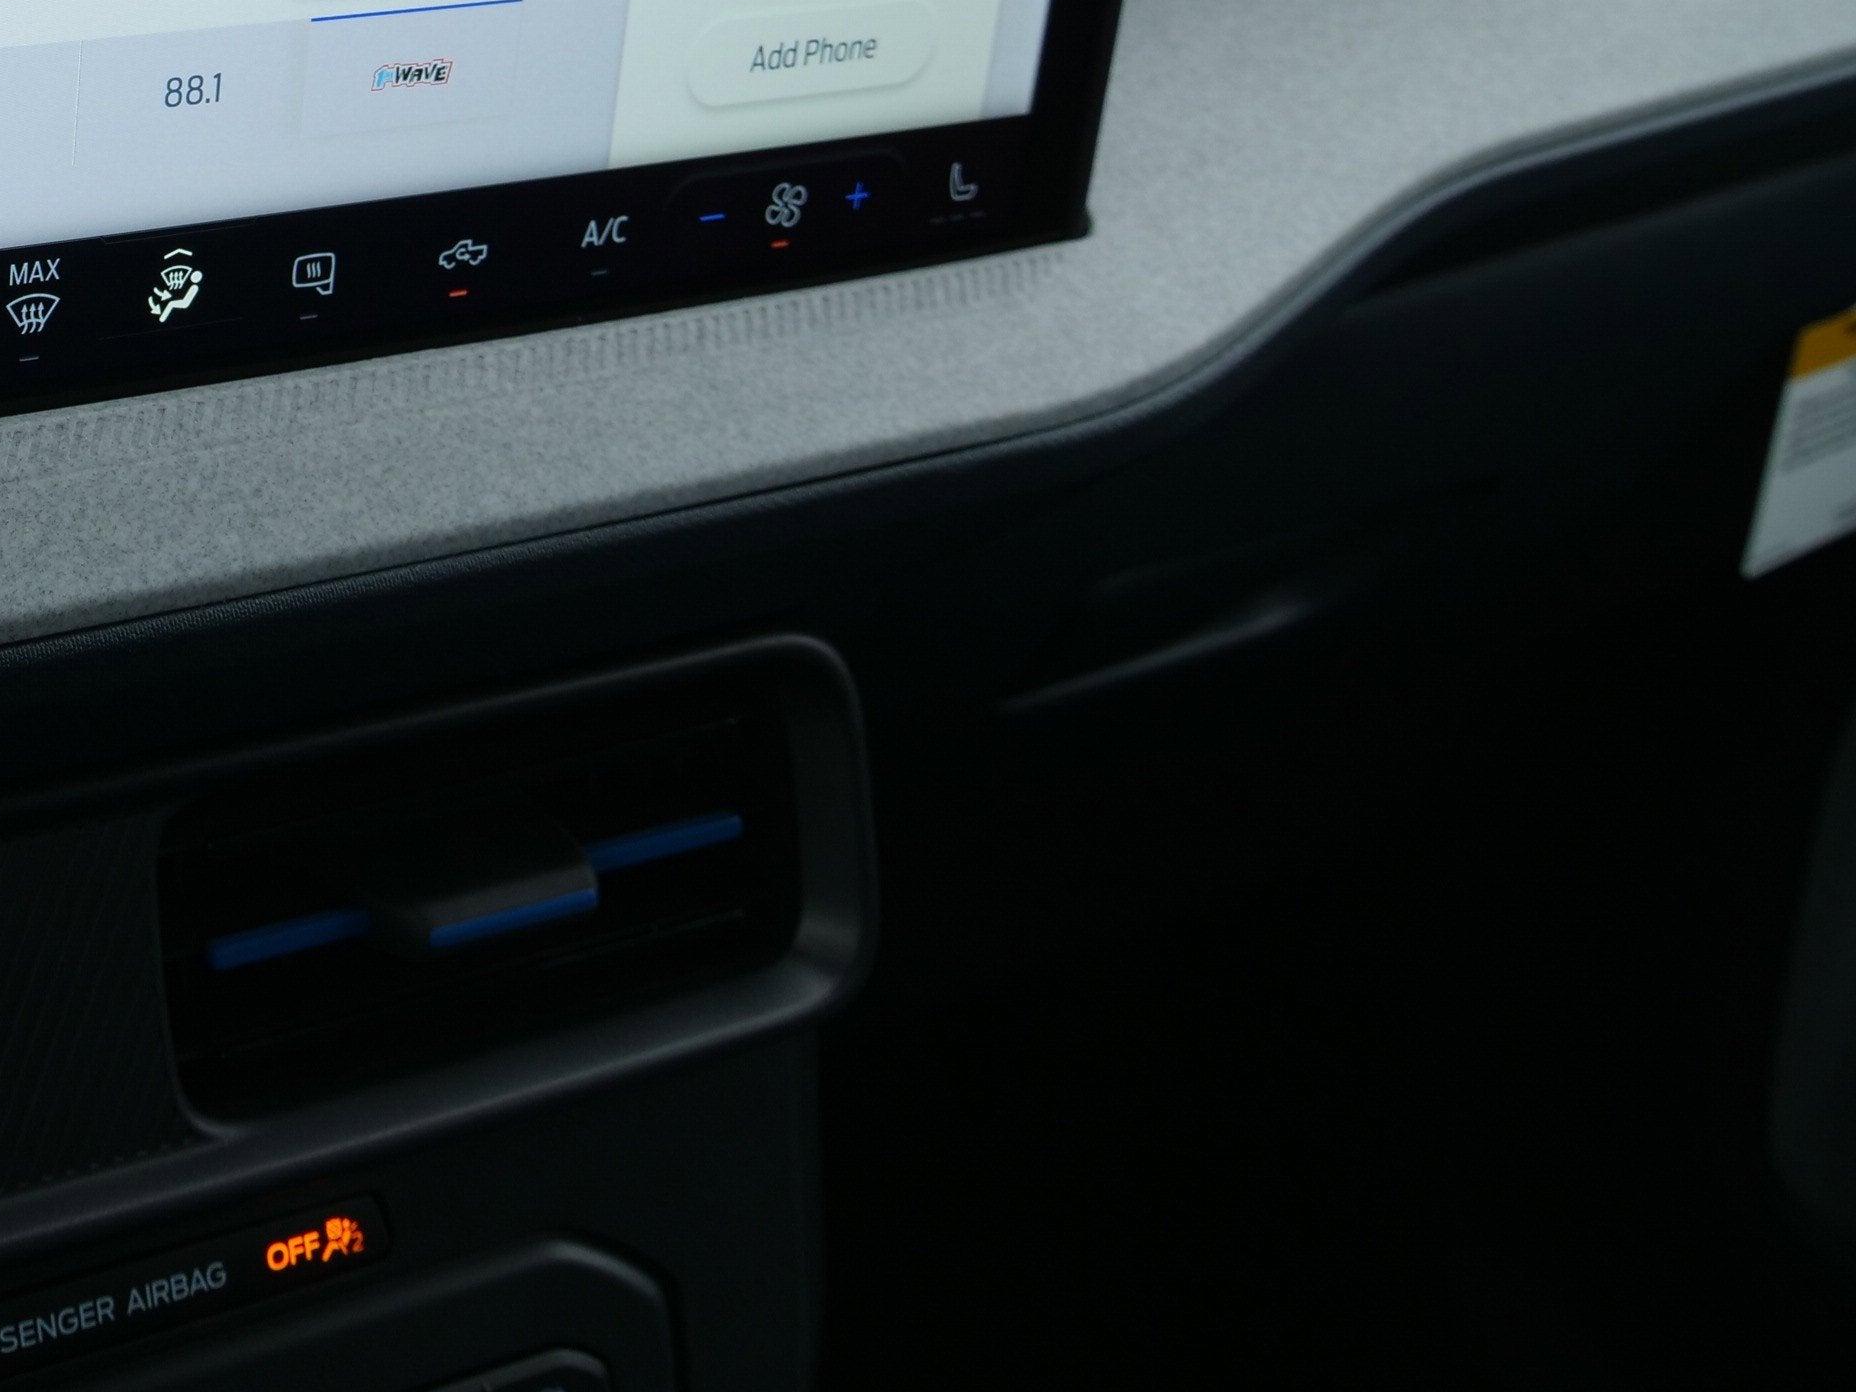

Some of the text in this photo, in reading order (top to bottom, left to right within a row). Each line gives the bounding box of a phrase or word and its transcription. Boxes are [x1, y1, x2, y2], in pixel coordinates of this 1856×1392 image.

[750, 33, 878, 73] Add Phone
[163, 72, 223, 109] 88.1
[394, 63, 448, 84] WAVE
[581, 214, 630, 248] A/C
[8, 257, 61, 286] MAX
[266, 1231, 320, 1271] OFF
[127, 1261, 227, 1314] AIRBAG
